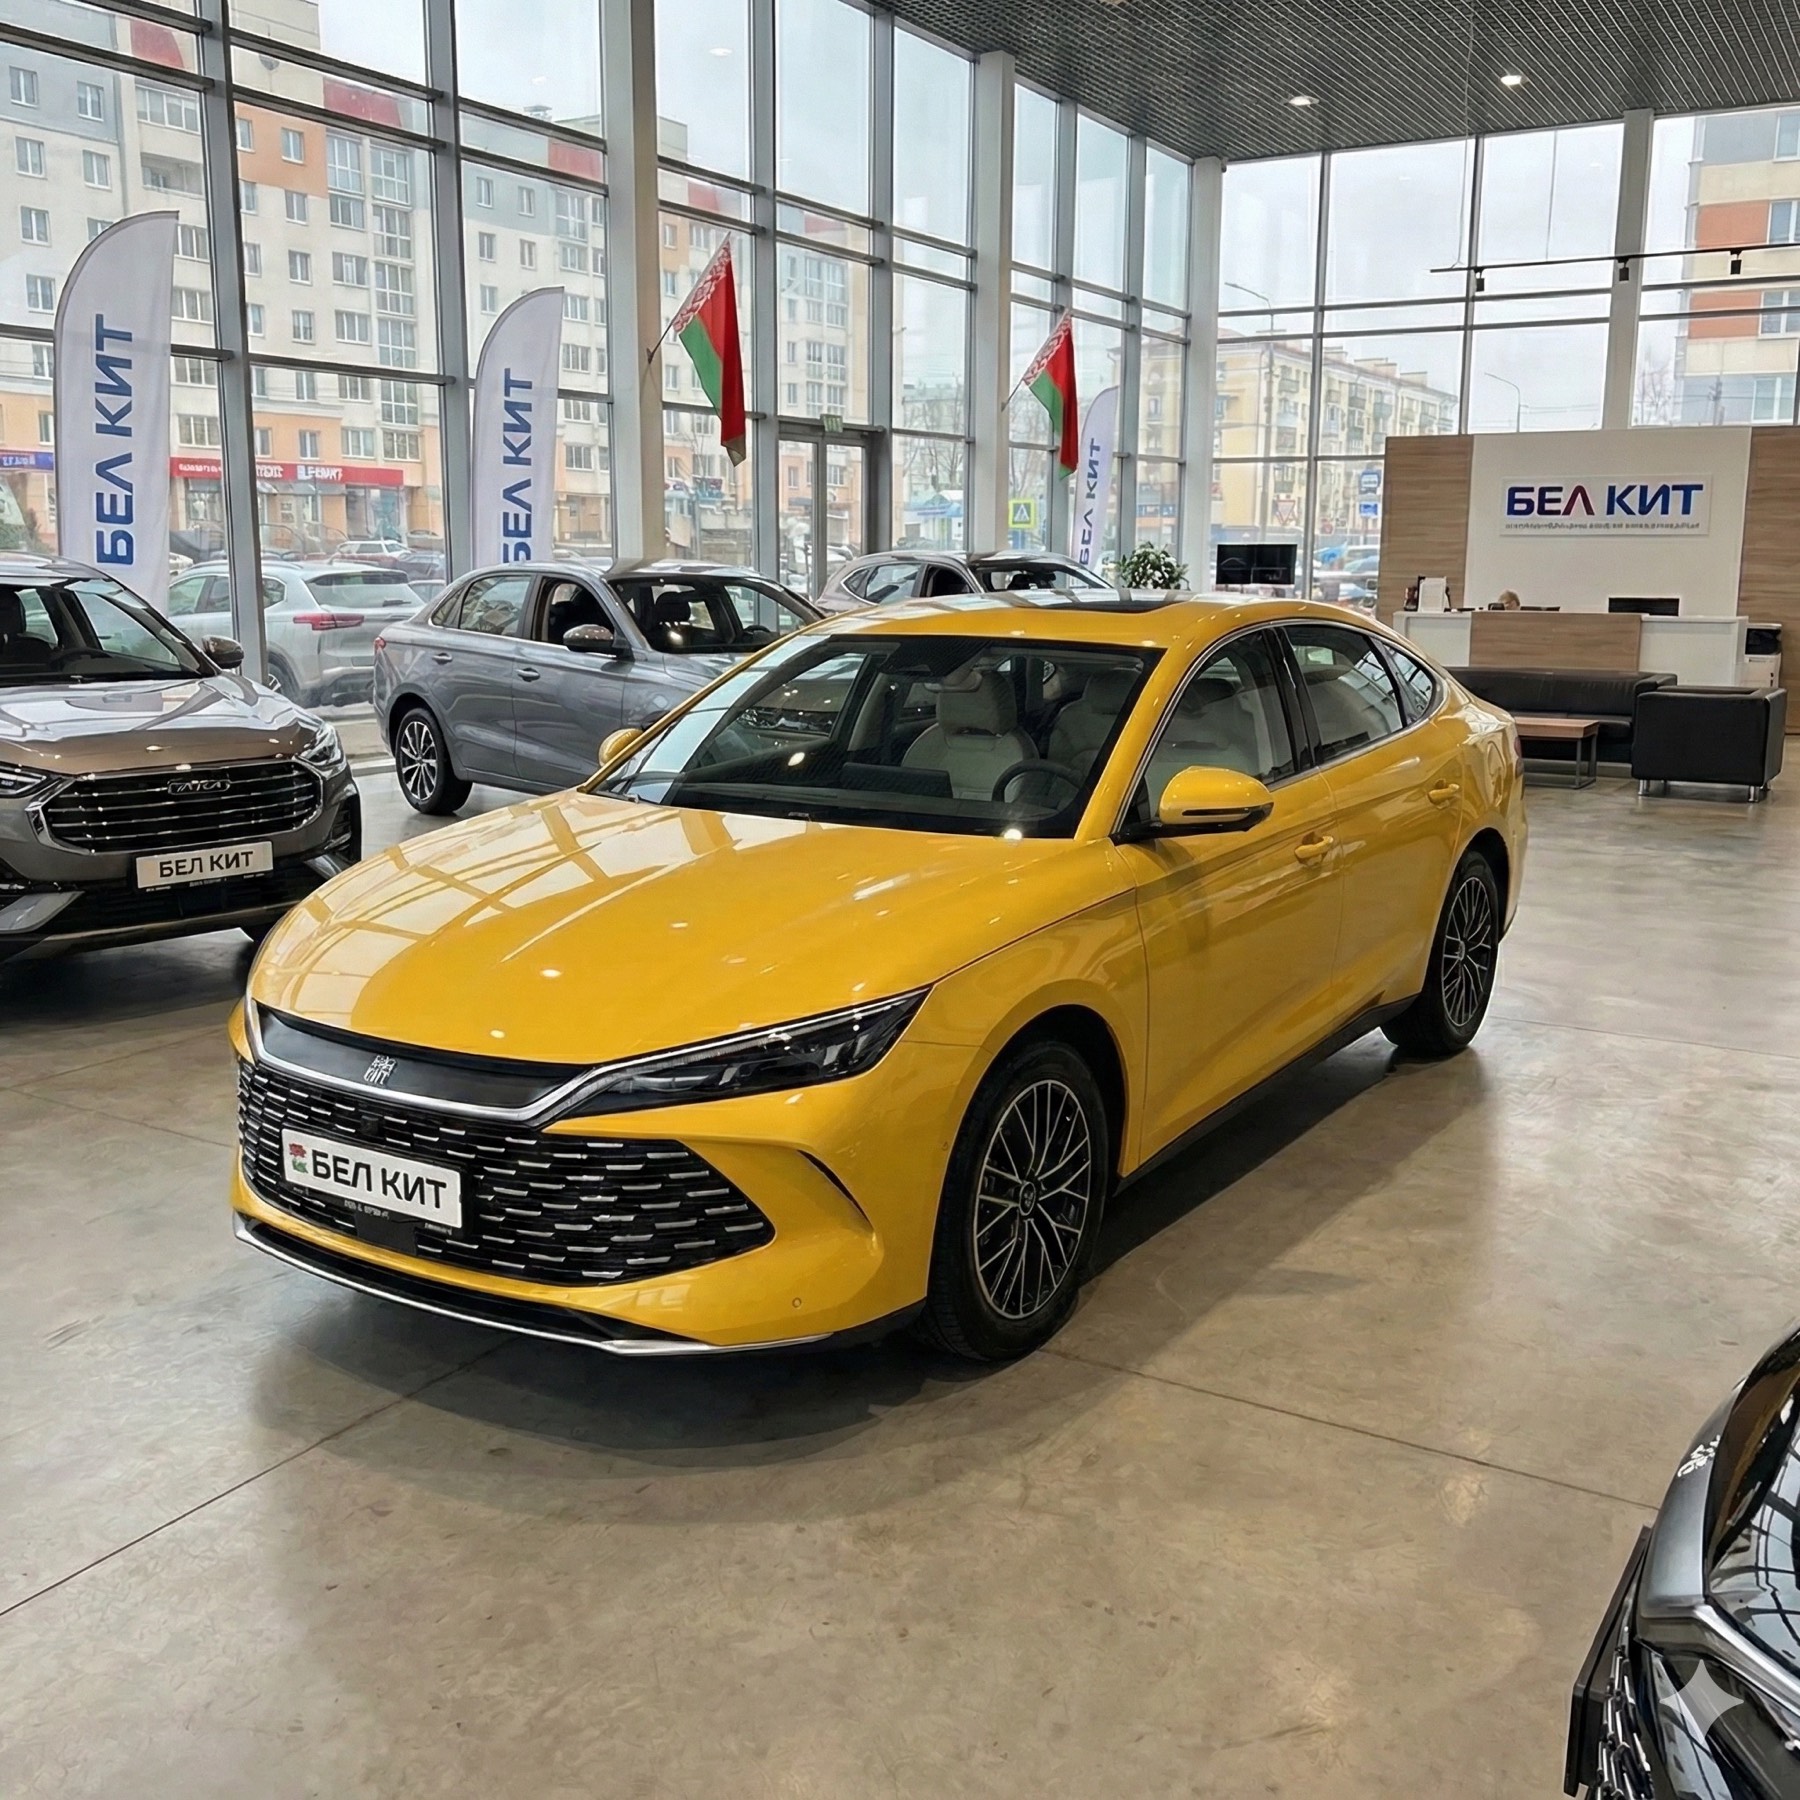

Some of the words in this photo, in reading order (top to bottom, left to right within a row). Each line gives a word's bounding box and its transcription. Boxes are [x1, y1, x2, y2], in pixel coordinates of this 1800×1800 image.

[94, 313, 133, 438] КИТ
[502, 367, 532, 466] КИТ
[1085, 437, 1101, 500] КИТ
[1506, 485, 1595, 516] БЕЛ
[1606, 484, 1704, 516] КИТ
[95, 452, 134, 566] БЕЛ
[502, 478, 532, 564] БЕЛ
[159, 857, 204, 878] БЕЛ
[209, 850, 254, 872] КИТ
[311, 1149, 373, 1192] БЕЛ
[381, 1167, 448, 1209] КИТ
